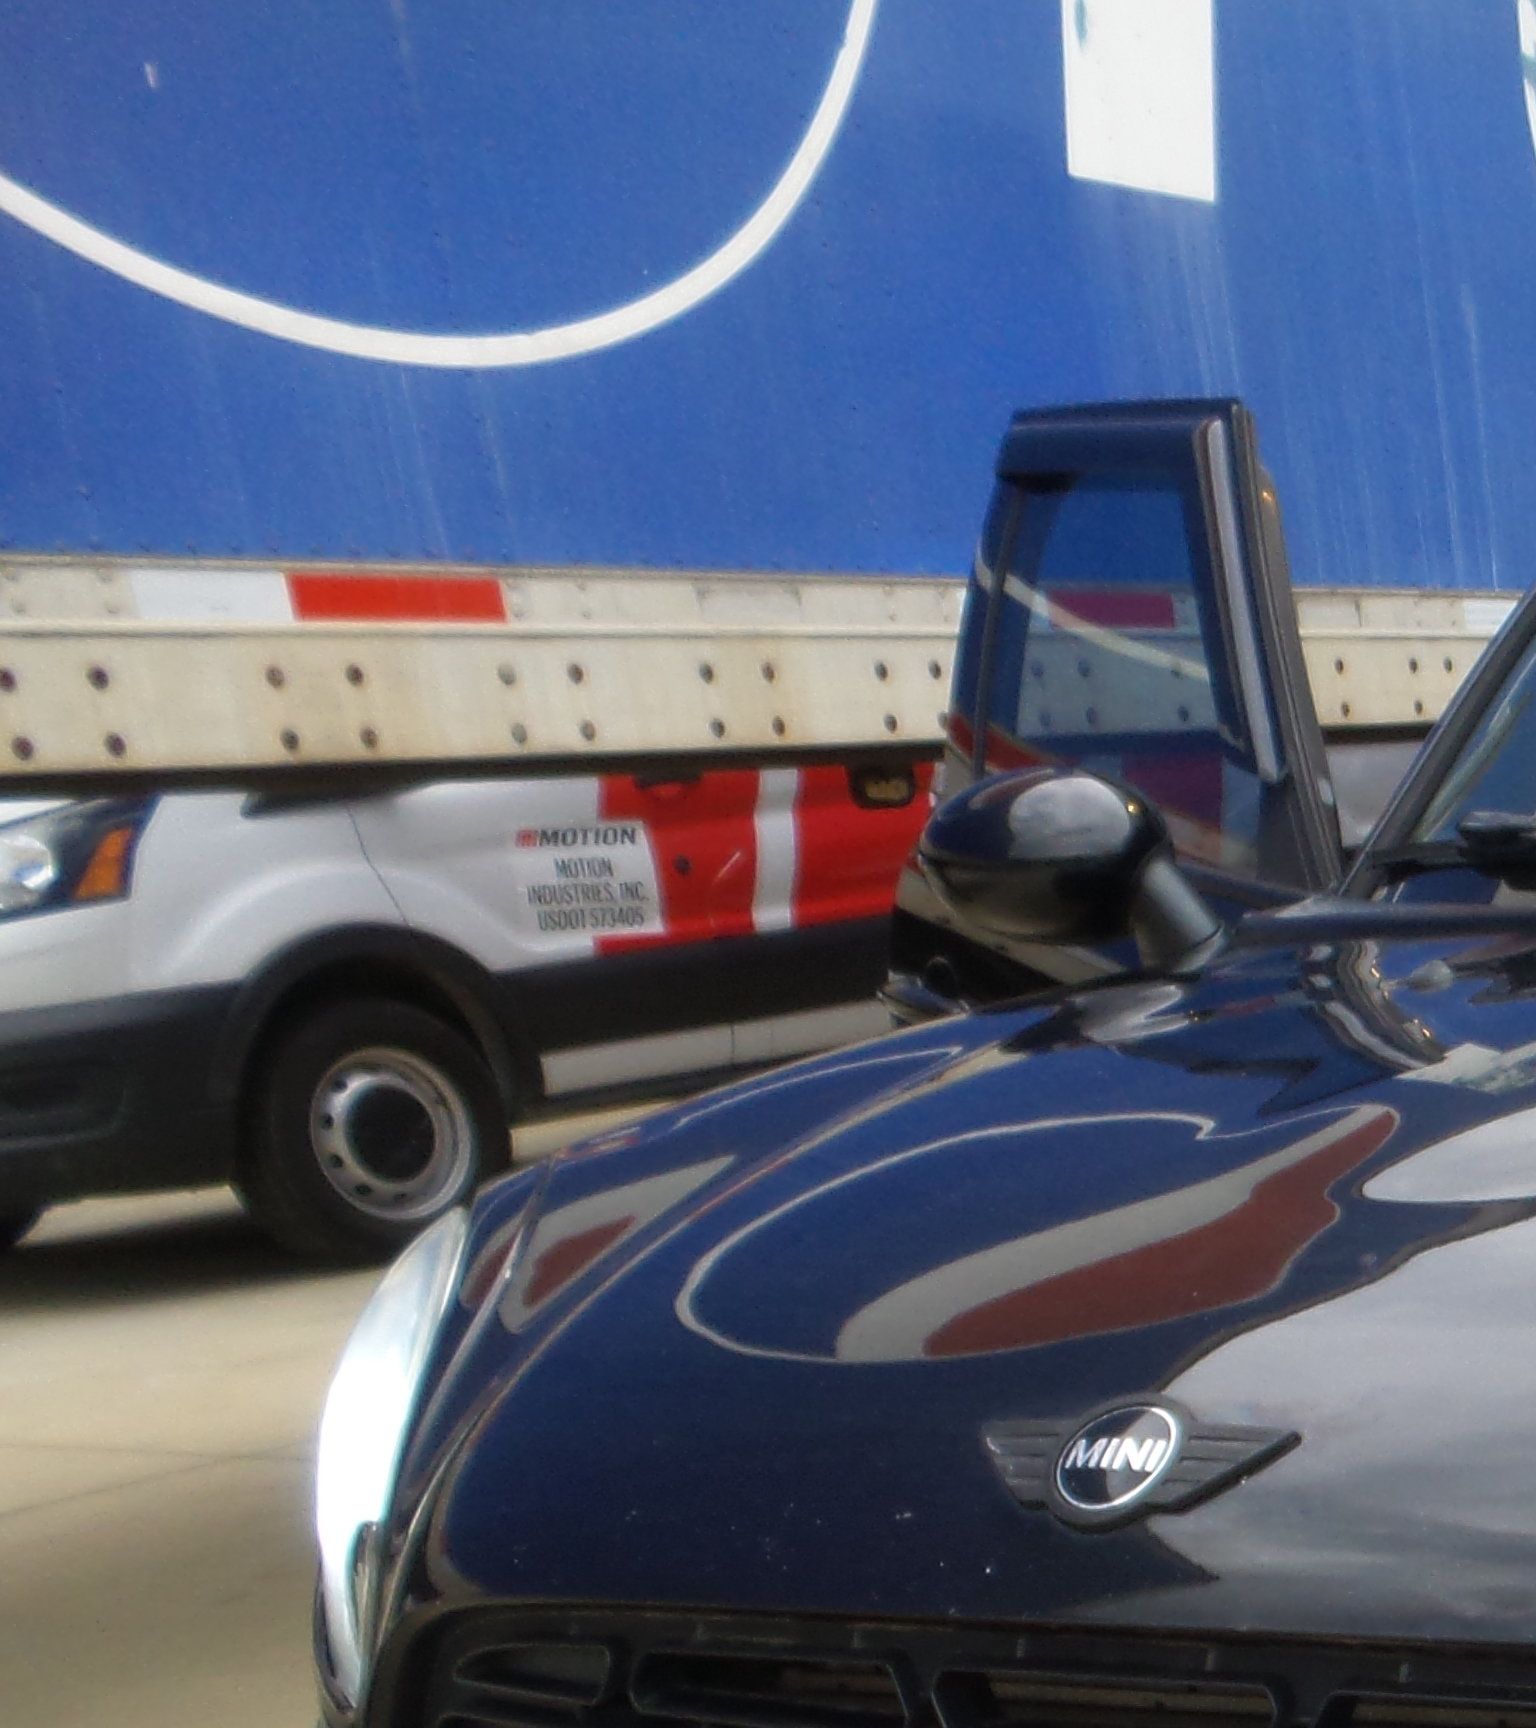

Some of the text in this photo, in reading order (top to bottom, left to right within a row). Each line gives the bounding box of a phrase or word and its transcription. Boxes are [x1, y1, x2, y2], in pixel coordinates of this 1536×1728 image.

[540, 826, 637, 847] MOTION
[553, 856, 614, 880] MOTION
[1064, 1436, 1167, 1472] MINI
